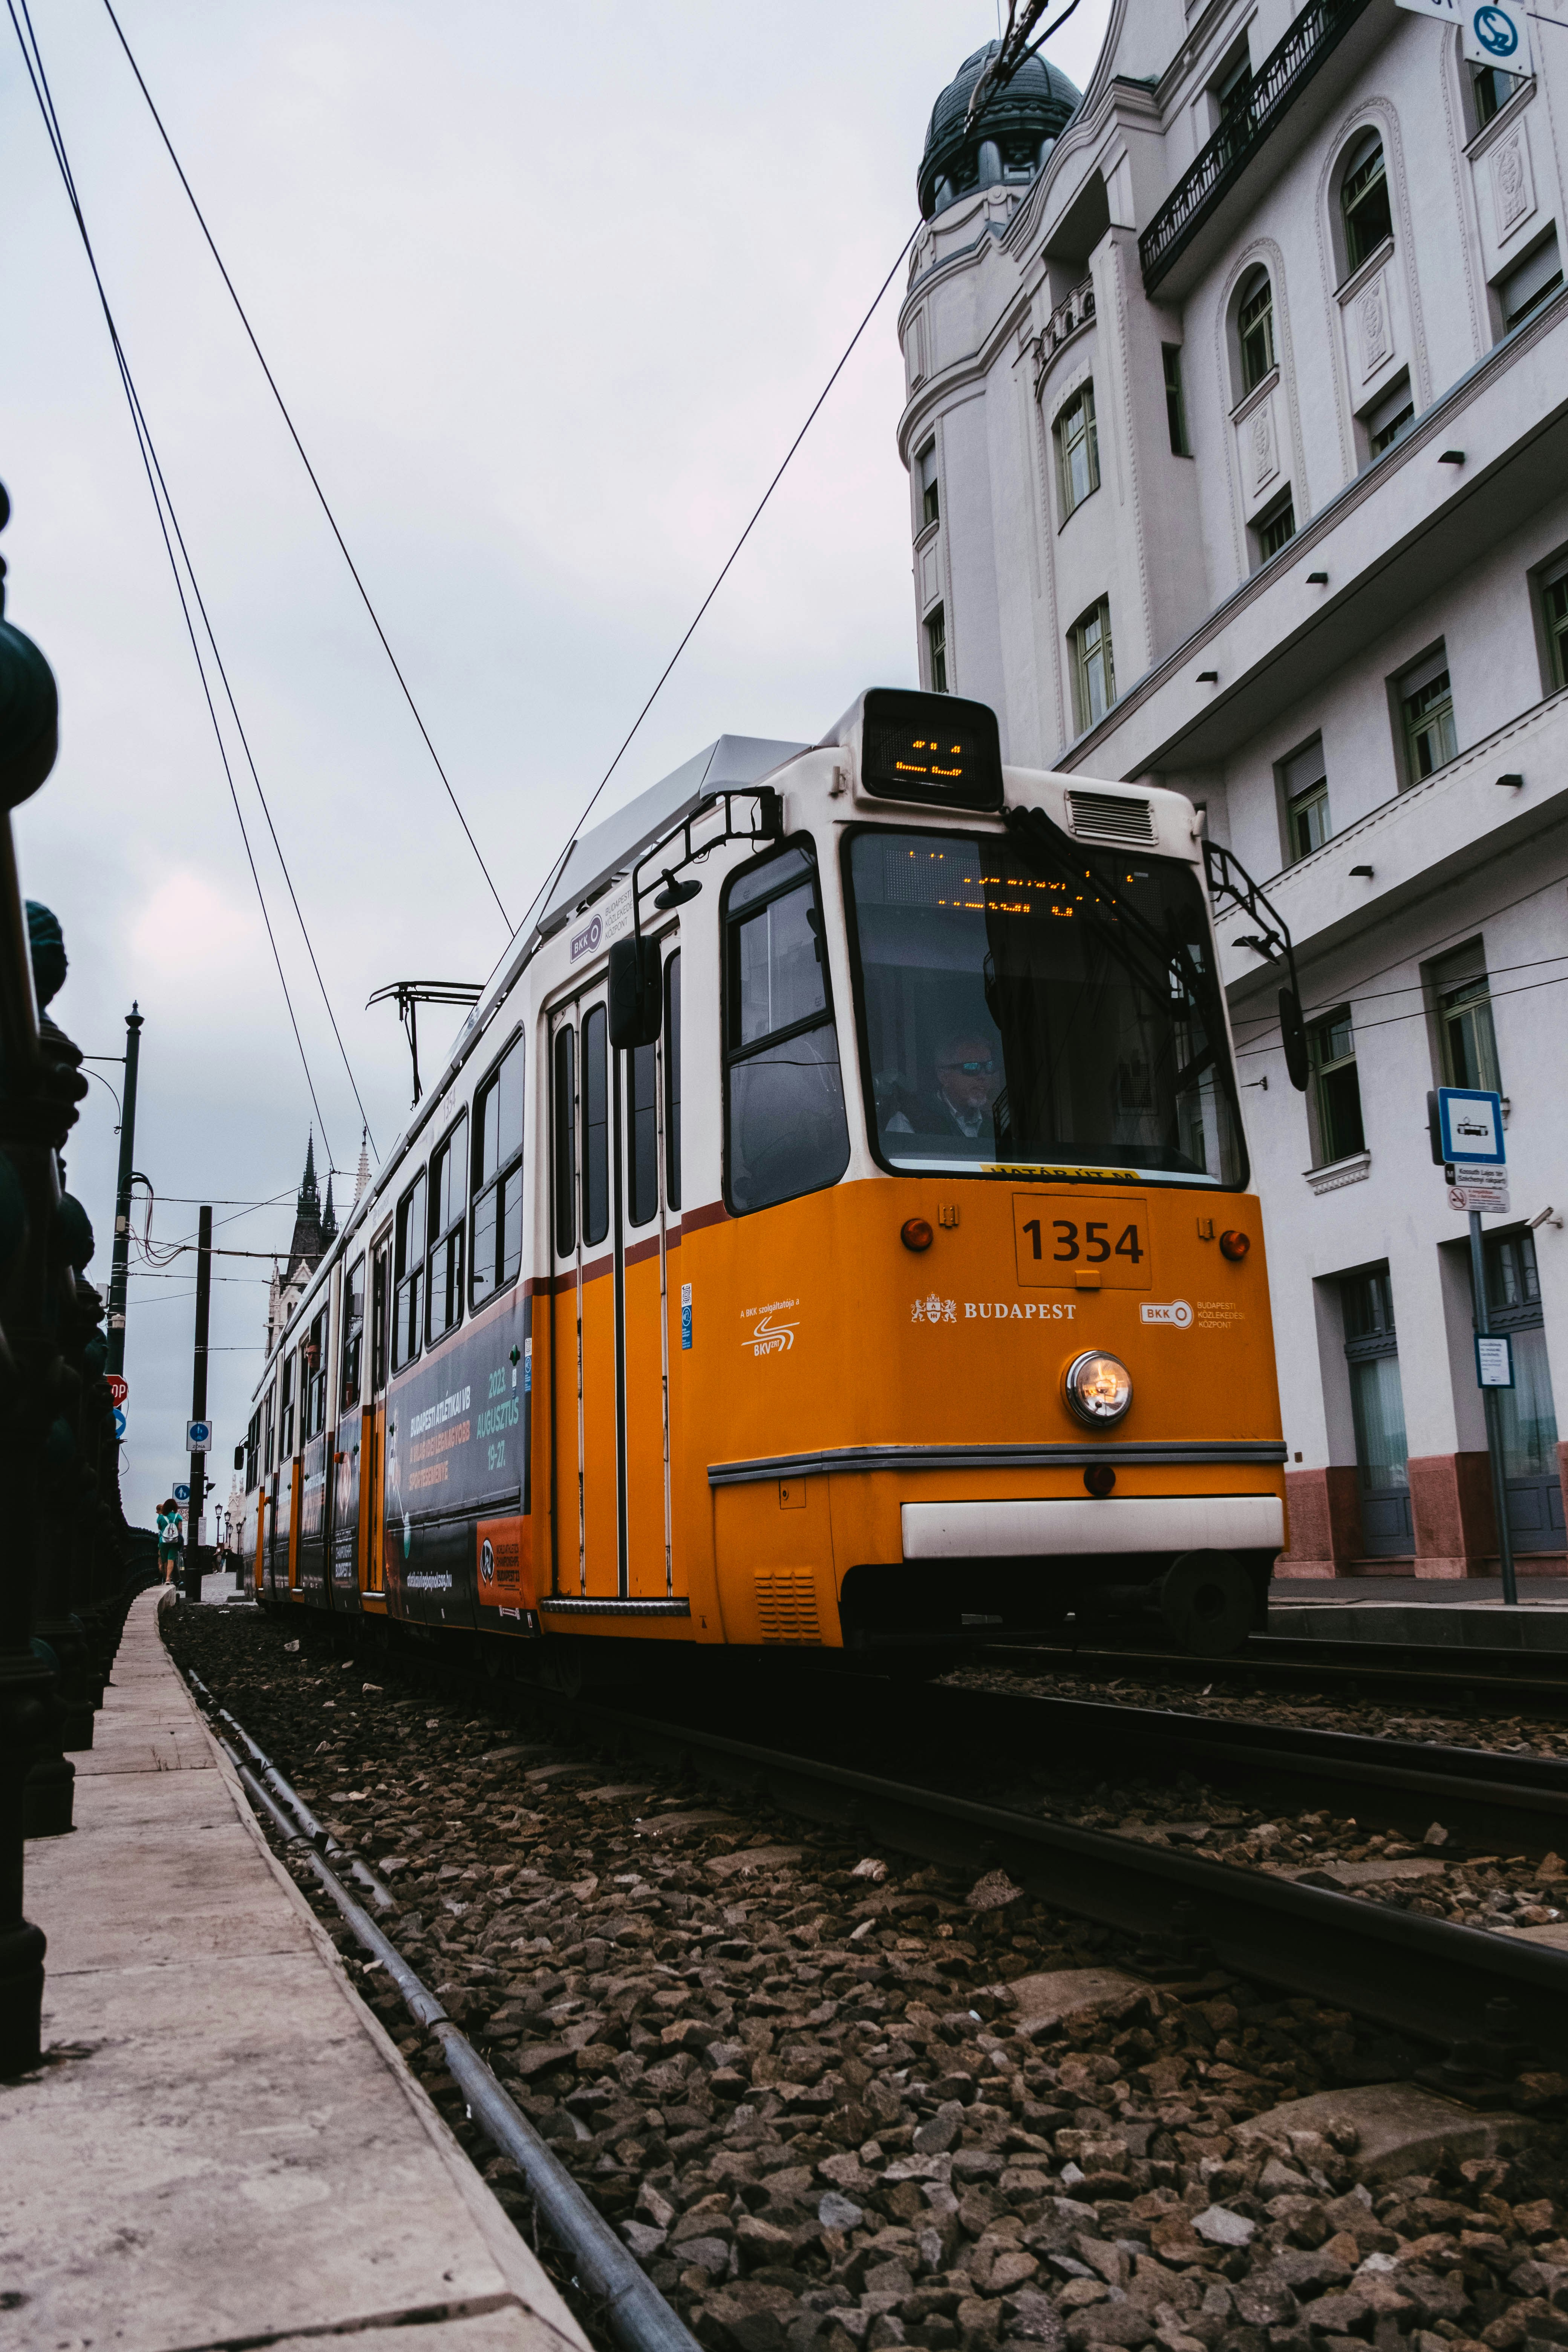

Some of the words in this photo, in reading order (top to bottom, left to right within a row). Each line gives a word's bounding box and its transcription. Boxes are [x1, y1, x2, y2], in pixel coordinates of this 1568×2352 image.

[605, 889, 631, 916] BUDAPESTI
[605, 897, 633, 929] KÖZLEKEDÉ
[605, 917, 628, 940] KÖZPONT
[574, 935, 588, 954] BKK
[444, 1085, 456, 1122] 1354
[1023, 1220, 1143, 1263] 1354
[746, 1307, 757, 1317] BKK
[759, 1298, 794, 1314] szolgáltatója
[964, 1303, 1076, 1319] BUDAPEST
[1147, 1309, 1170, 1318] BKK
[1199, 1320, 1231, 1328] KÖZPONT
[754, 1342, 771, 1357] BKV
[112, 1384, 126, 1398] OP
[488, 1366, 506, 1399] 2023.
[410, 1406, 435, 1438] BUDAPESTI
[435, 1390, 461, 1425] ATLÉTIKAI
[462, 1386, 471, 1411] VB
[477, 1396, 519, 1440] AUGUSZTUS
[435, 1419, 470, 1456] LEGNAGYOBB
[488, 1440, 505, 1471] 19-27.
